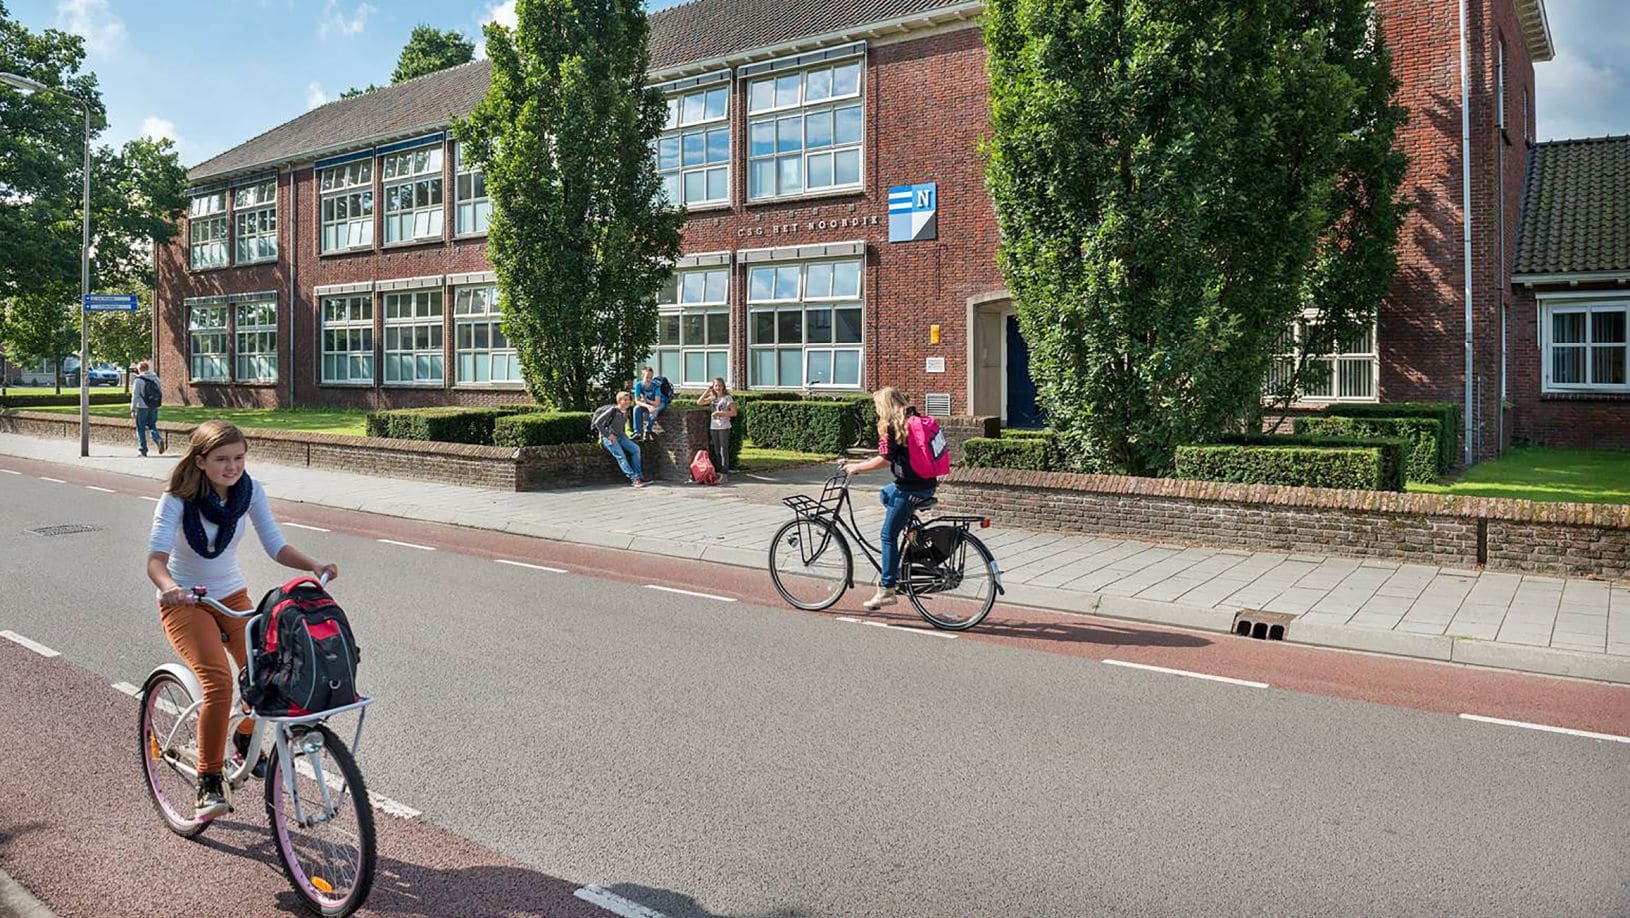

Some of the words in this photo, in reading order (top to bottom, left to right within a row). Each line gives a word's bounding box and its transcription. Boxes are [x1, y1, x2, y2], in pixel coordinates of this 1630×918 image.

[916, 189, 930, 208] N
[737, 227, 763, 237] CSG
[773, 223, 798, 234] HET
